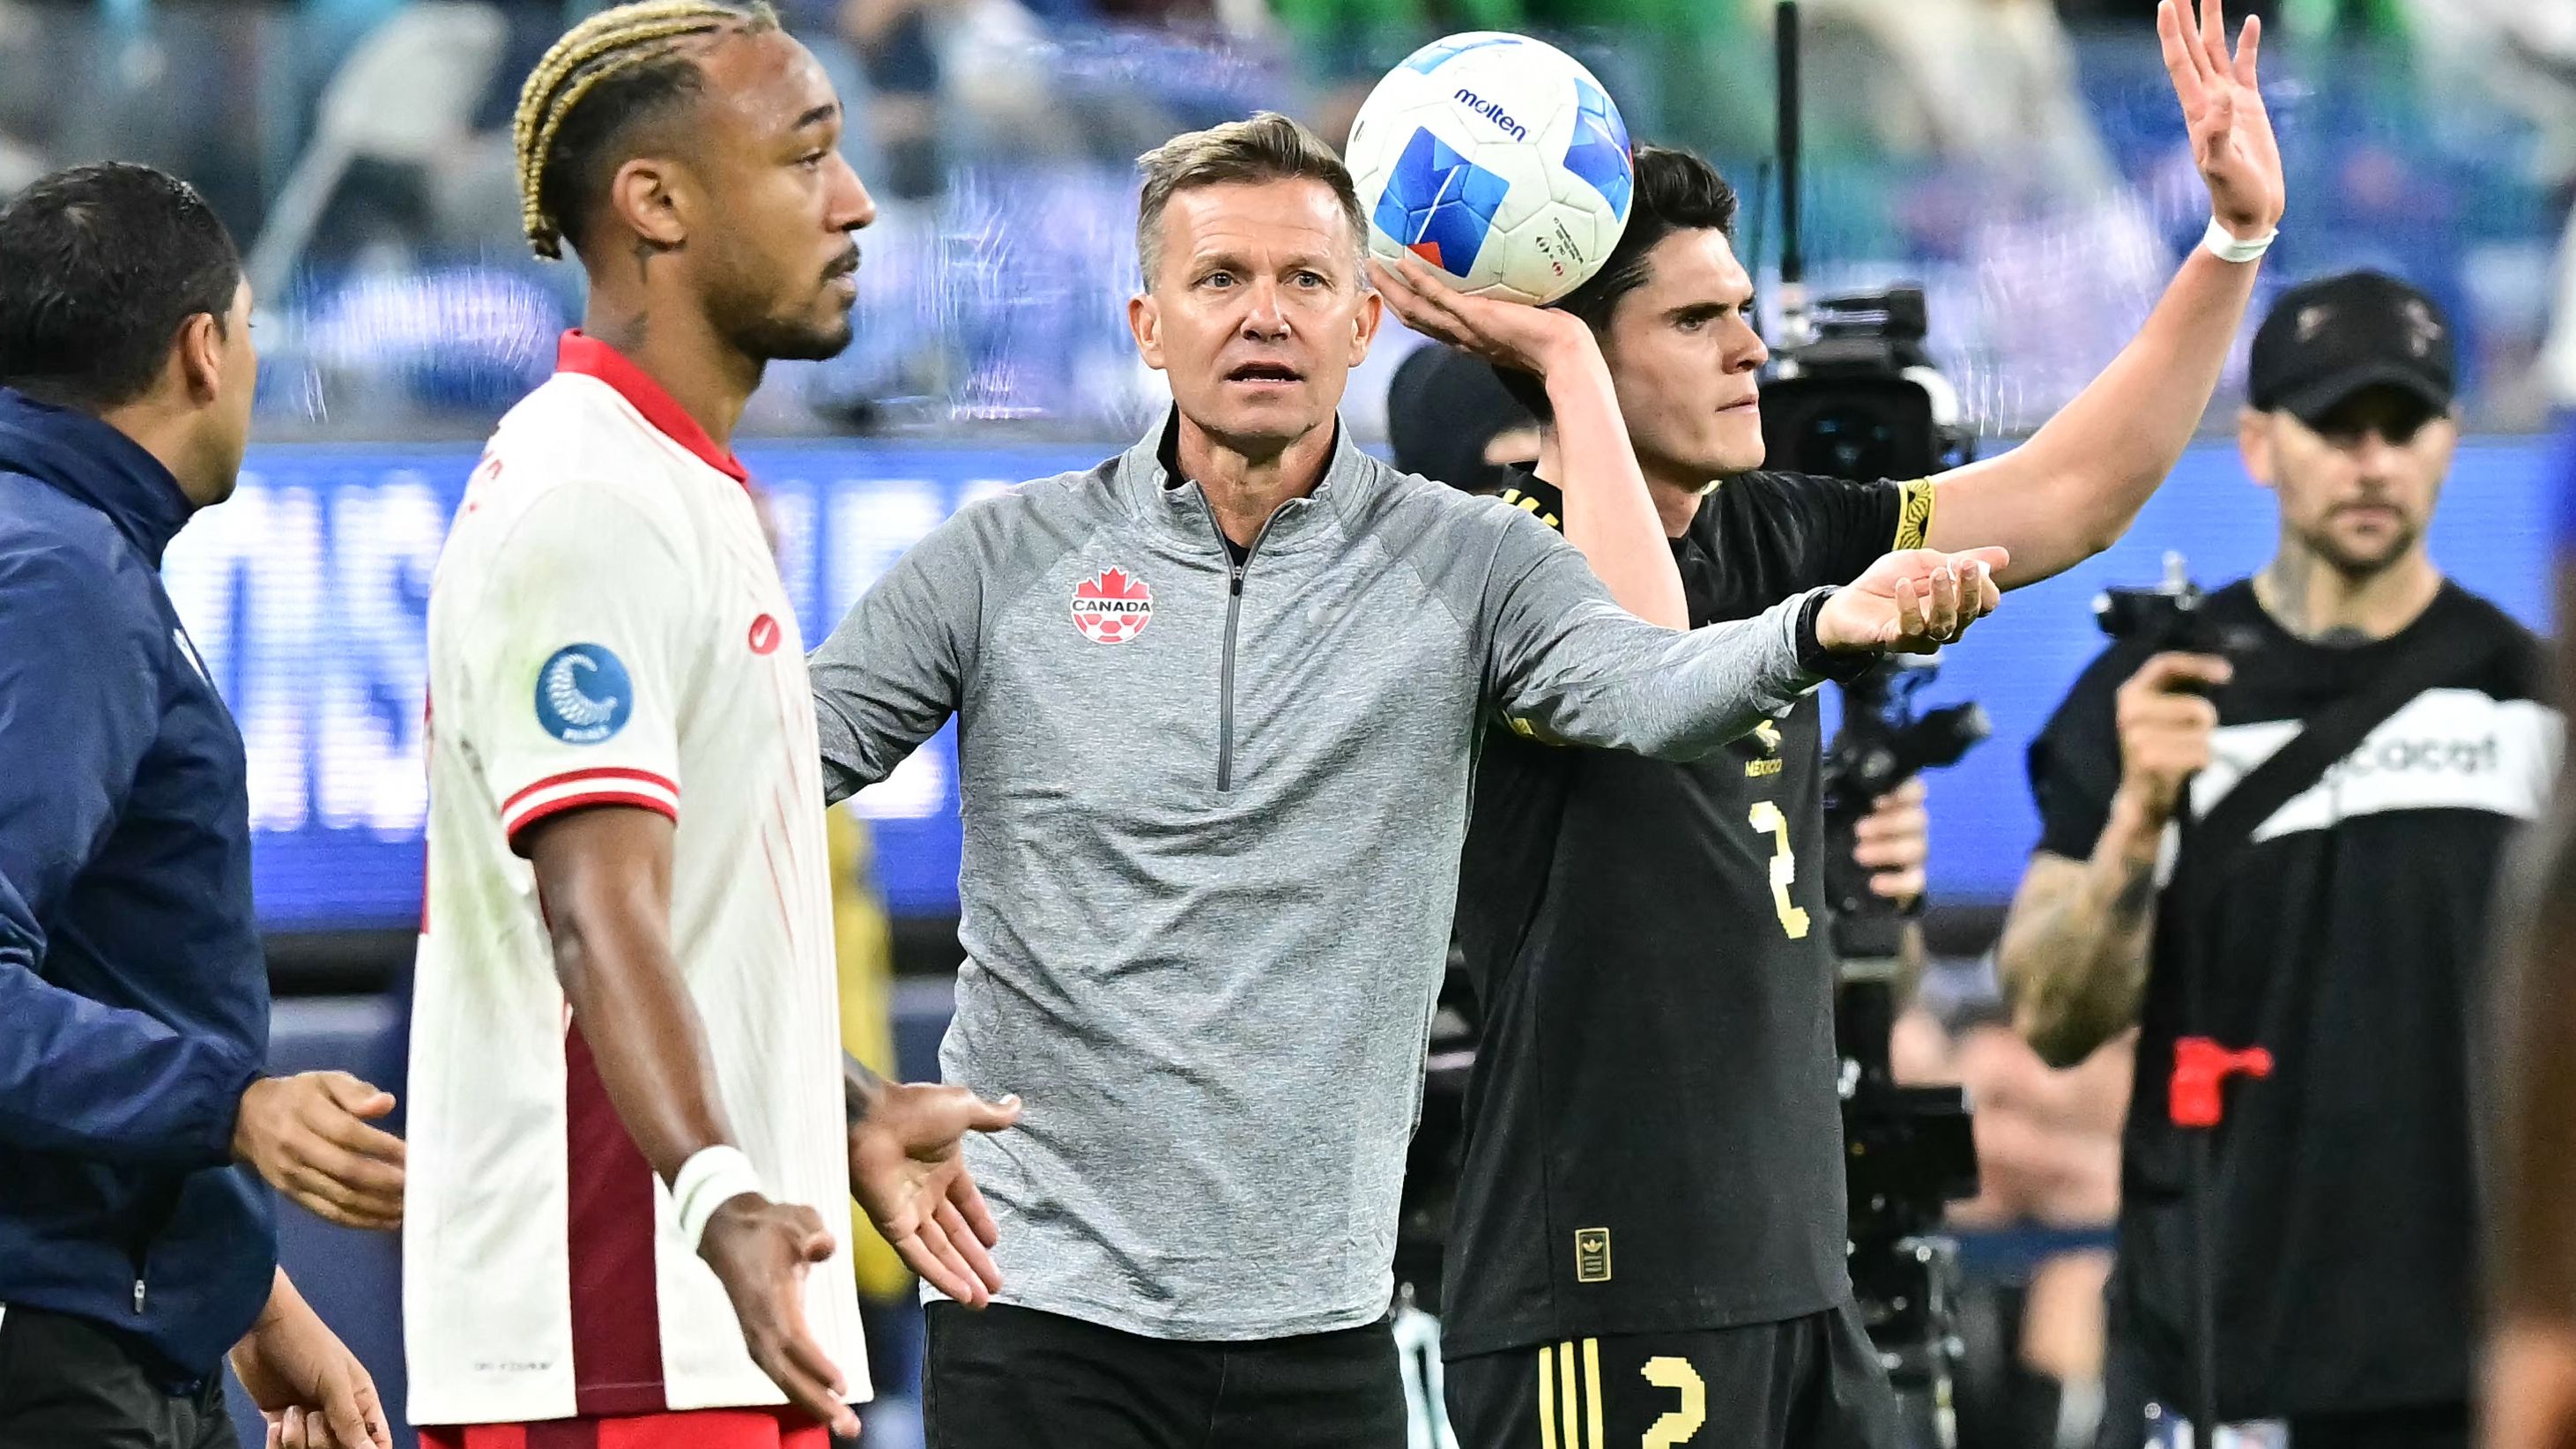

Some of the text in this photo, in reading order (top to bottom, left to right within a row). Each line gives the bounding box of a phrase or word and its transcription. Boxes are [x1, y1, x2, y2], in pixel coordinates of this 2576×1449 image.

[1453, 89, 1526, 142] molten
[1072, 600, 1151, 613] CANADA
[1748, 800, 1810, 940] 2
[1641, 1356, 1706, 1449] 2
